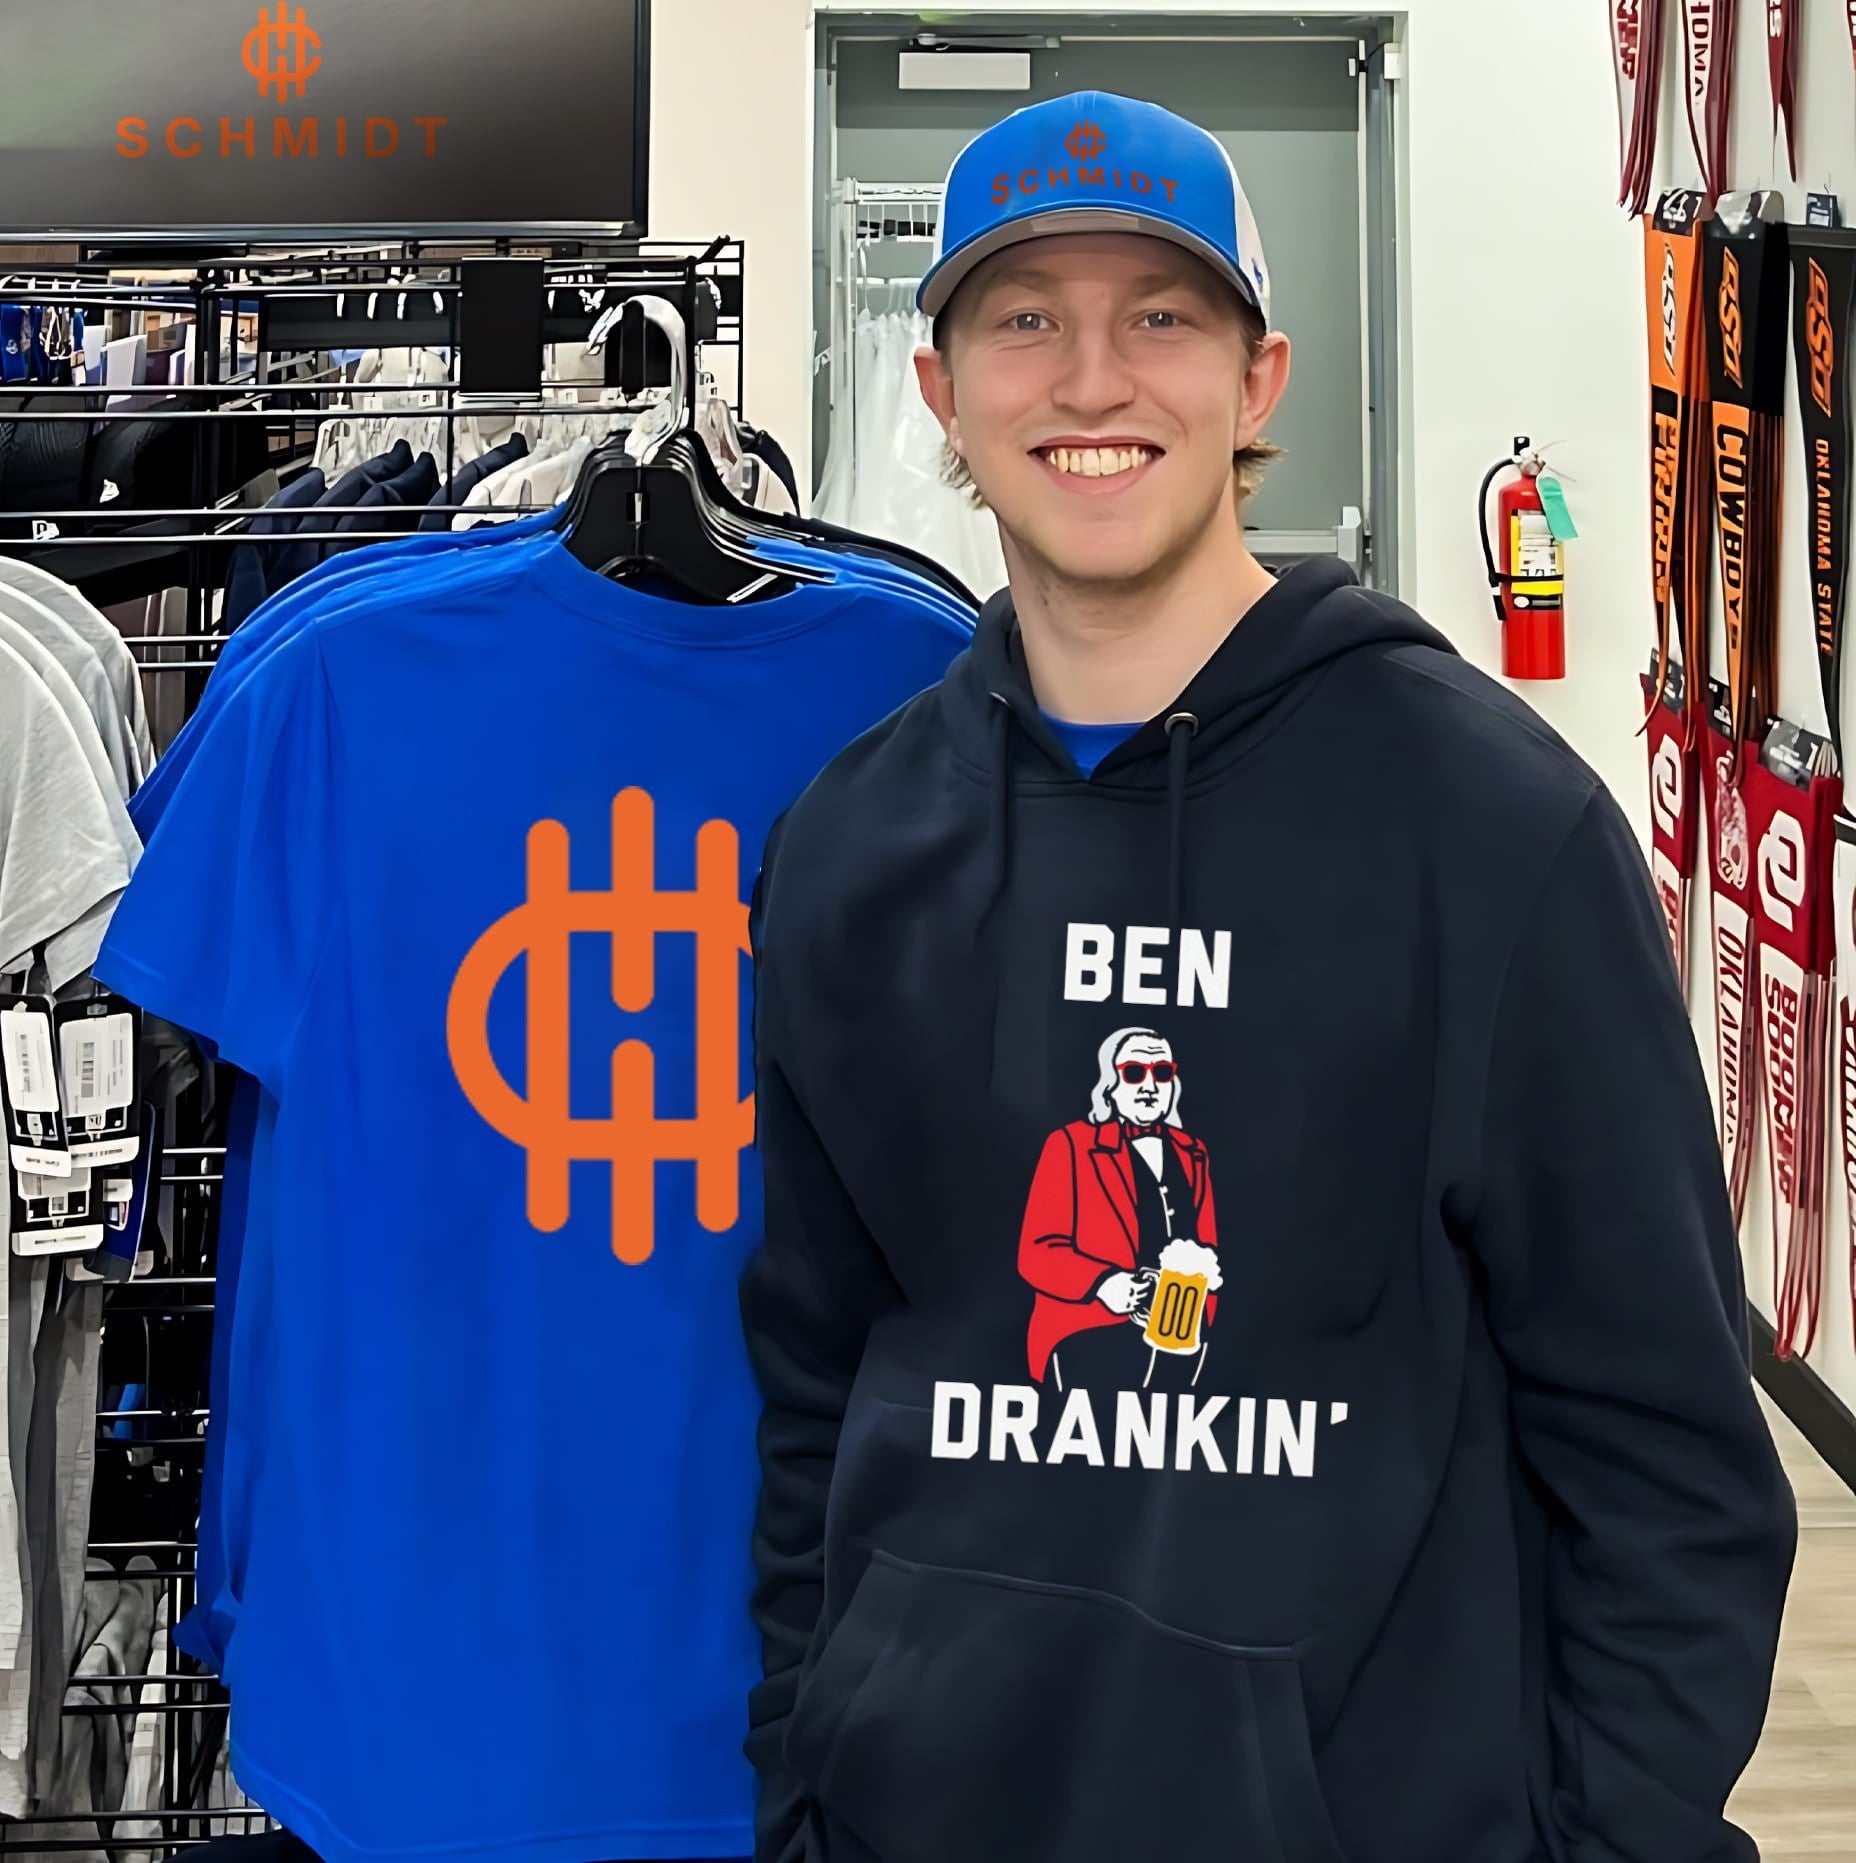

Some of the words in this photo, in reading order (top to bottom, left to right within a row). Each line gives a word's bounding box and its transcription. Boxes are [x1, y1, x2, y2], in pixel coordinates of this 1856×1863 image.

[115, 116, 448, 159] SCHMIDT
[991, 167, 1180, 205] SCHMIDT
[1815, 438, 1832, 570] OKLAHOMA
[1063, 922, 1232, 1009] BEN
[930, 1380, 1349, 1478] DRANKIN'
